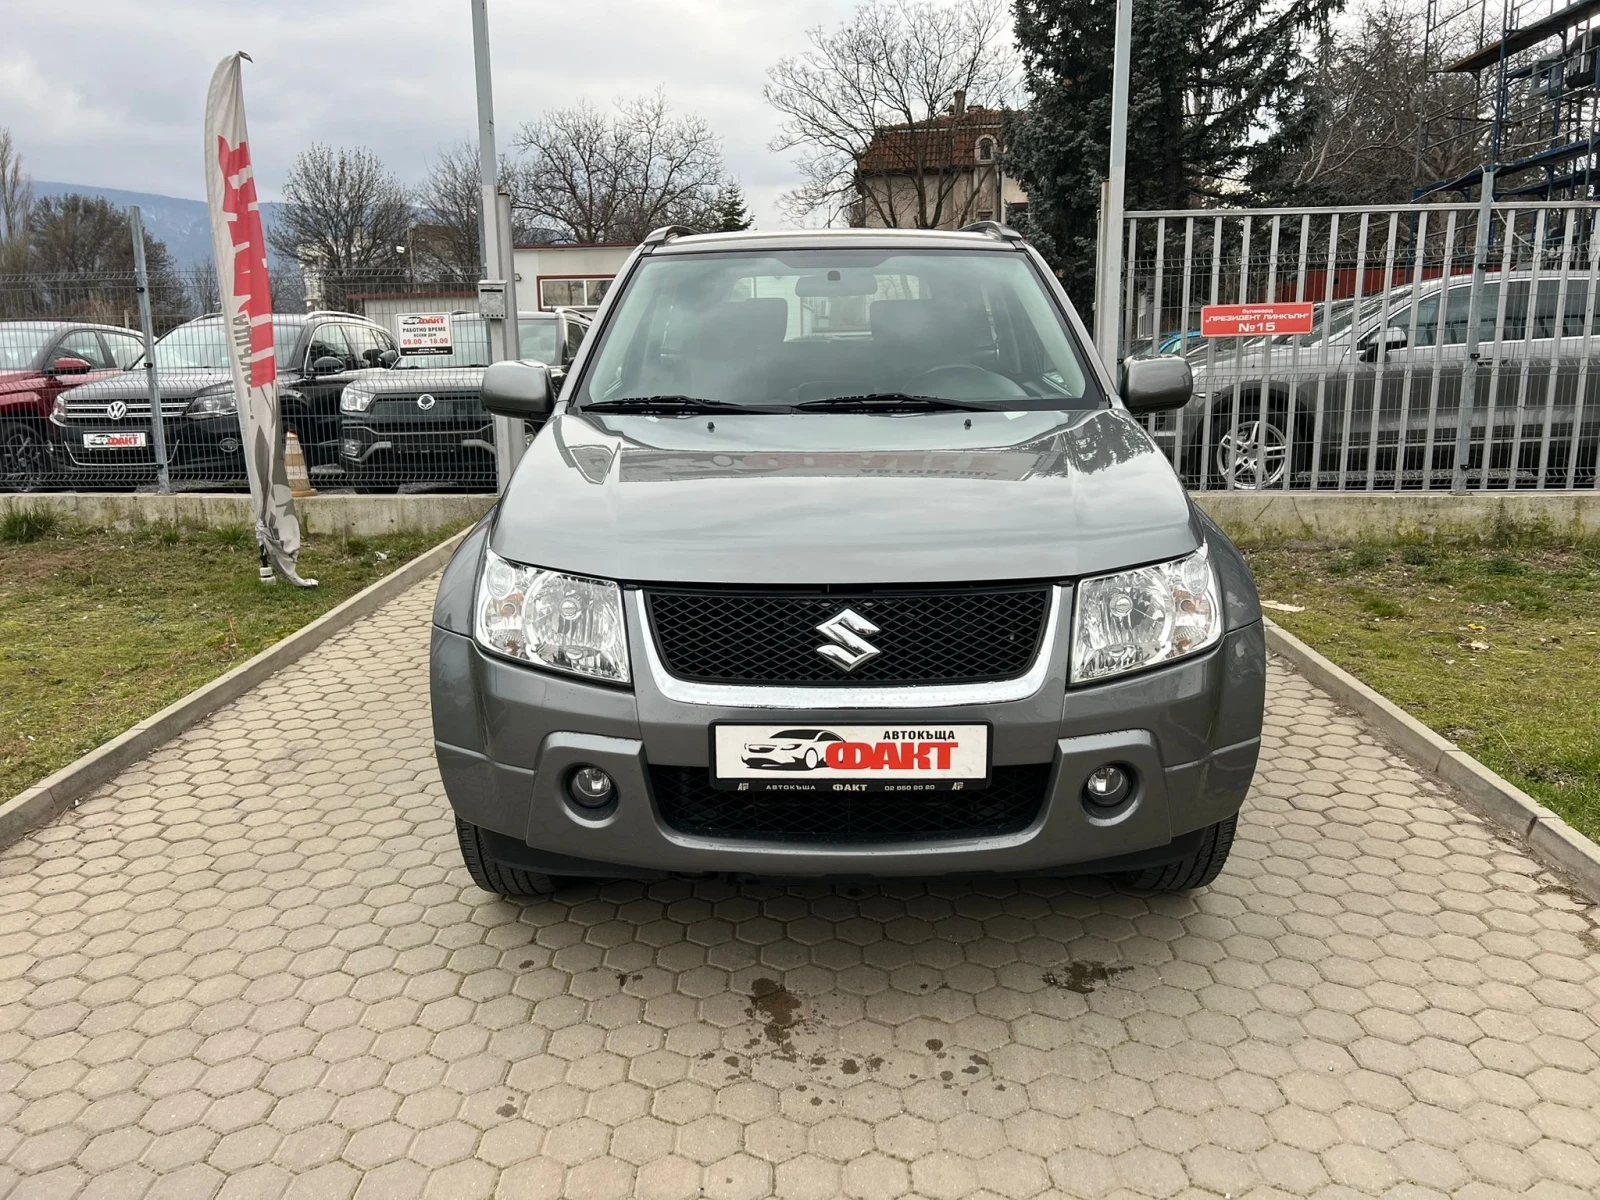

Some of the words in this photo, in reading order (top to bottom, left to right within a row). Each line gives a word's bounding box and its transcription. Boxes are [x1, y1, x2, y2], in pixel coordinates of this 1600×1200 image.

[1238, 322, 1276, 333] №15
[883, 730, 956, 741] АВТОКЪЩА
[825, 742, 959, 770] ФАКТ
[832, 783, 868, 791] ФАКТ
